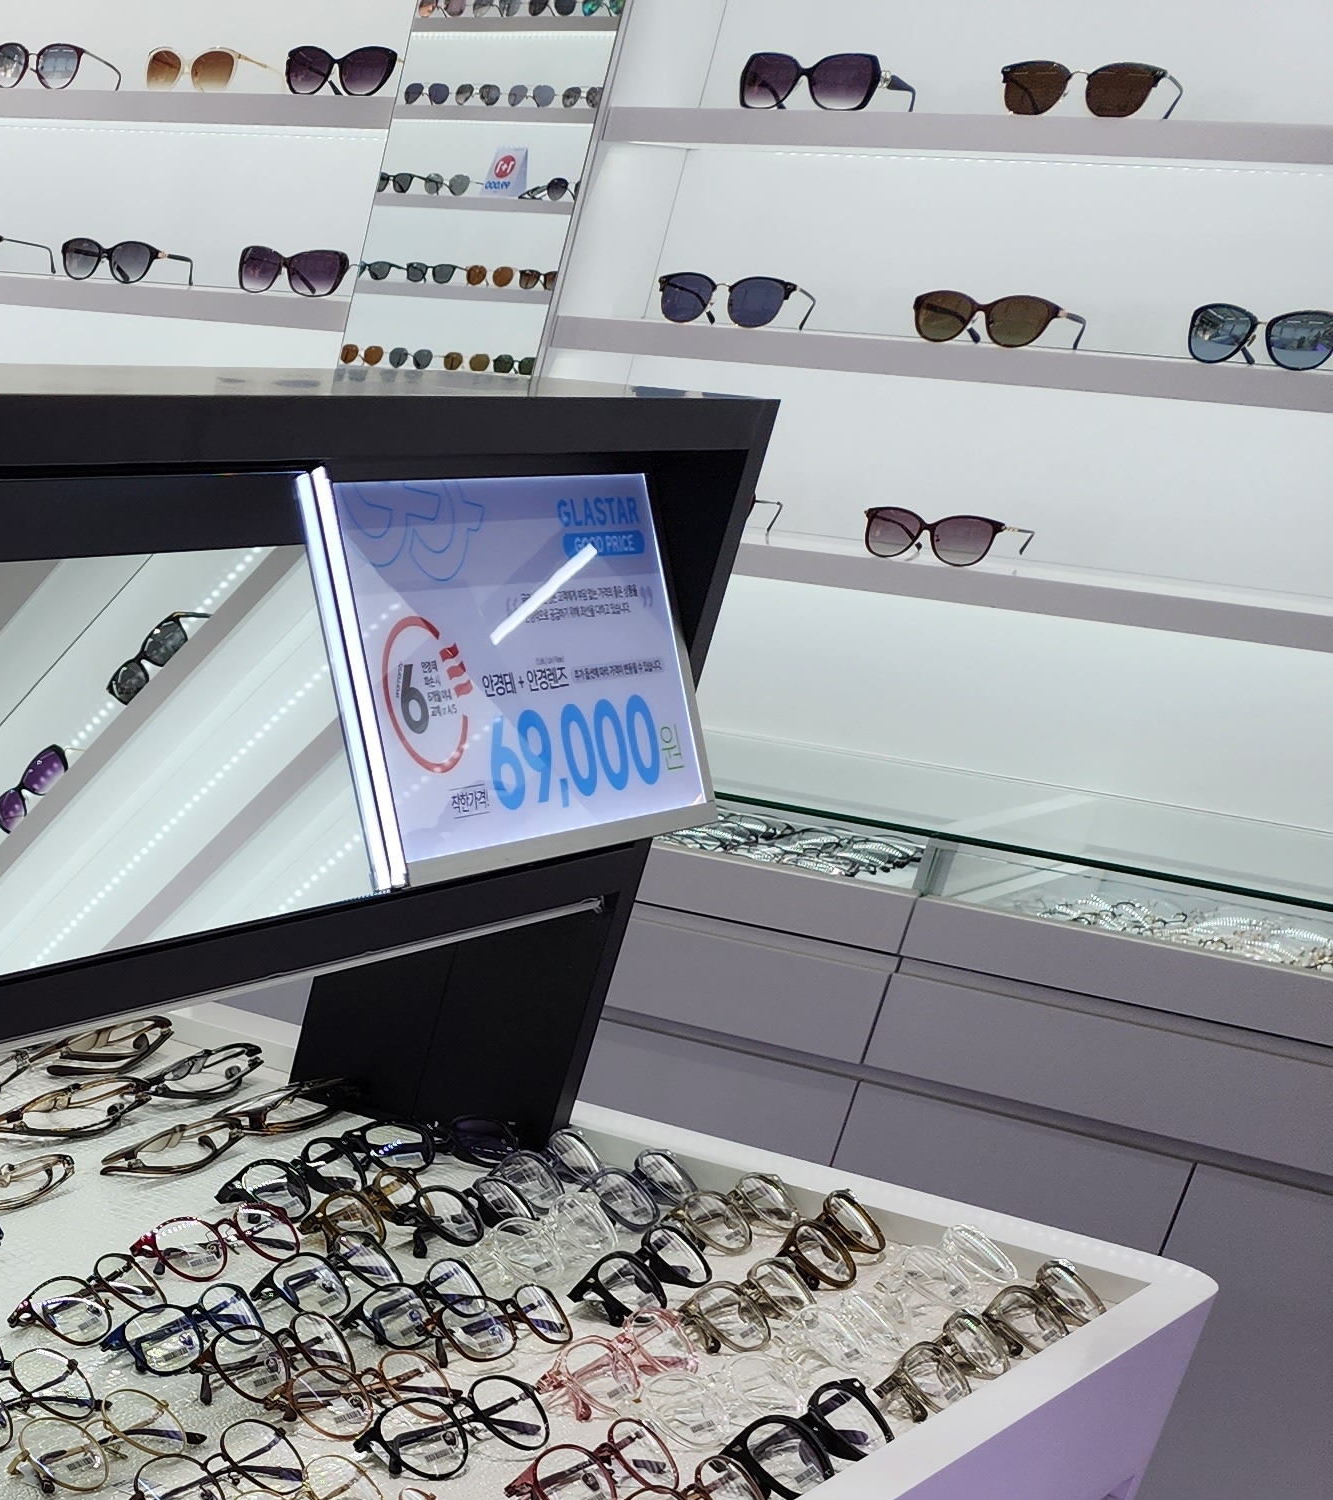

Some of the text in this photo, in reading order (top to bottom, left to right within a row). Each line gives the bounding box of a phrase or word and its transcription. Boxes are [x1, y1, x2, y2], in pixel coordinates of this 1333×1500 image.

[557, 496, 640, 528] GLASTAR
[606, 534, 635, 552] PRICE
[481, 671, 517, 698] 안경테
[527, 666, 570, 693] 안경렌즈
[400, 663, 430, 735] 6
